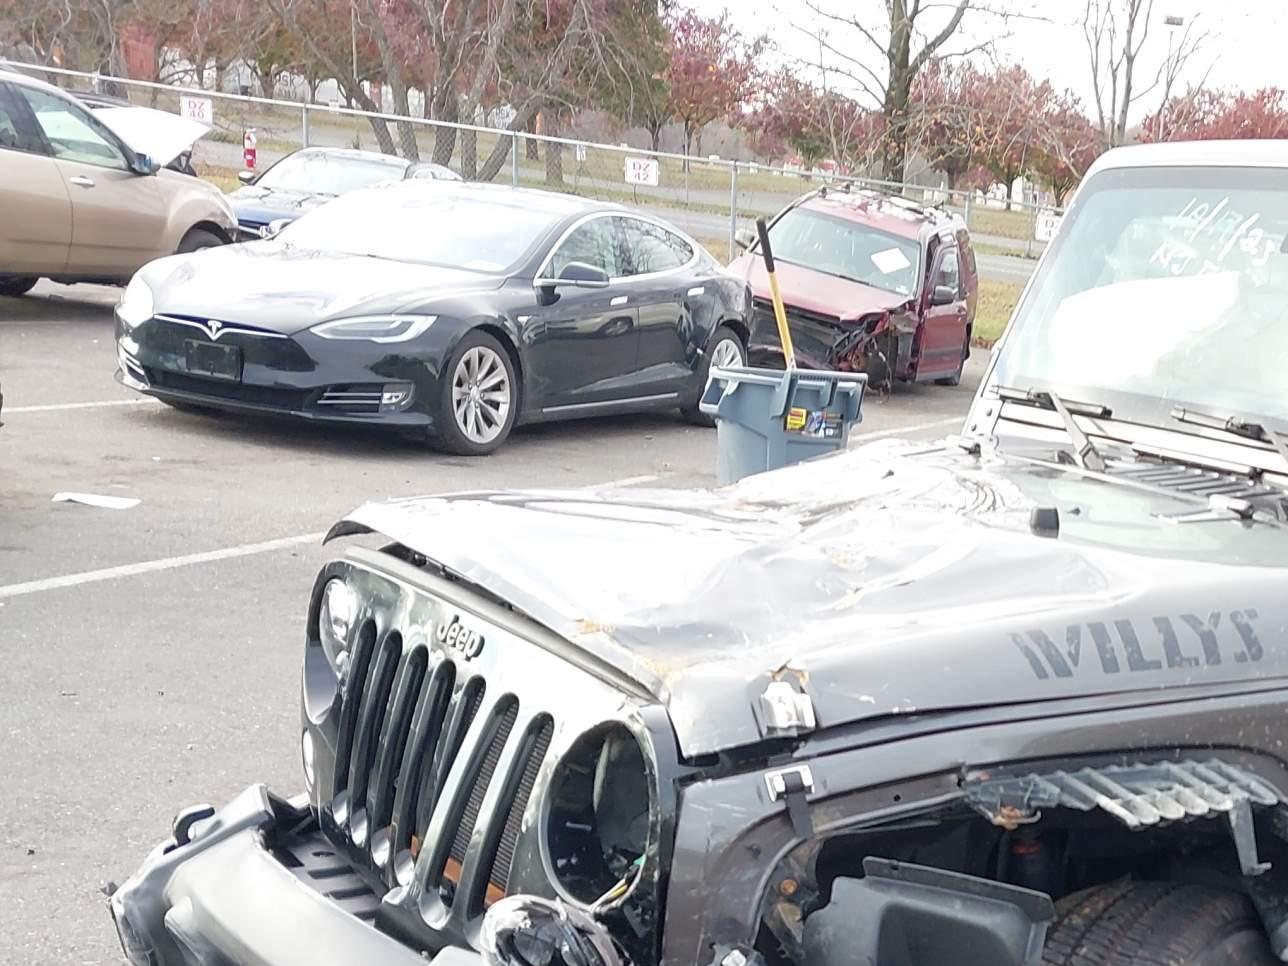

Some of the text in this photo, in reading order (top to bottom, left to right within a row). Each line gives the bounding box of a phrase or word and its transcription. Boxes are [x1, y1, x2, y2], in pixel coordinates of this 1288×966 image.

[632, 161, 650, 171] DZ
[436, 614, 486, 662] Jeep
[1007, 608, 1264, 680] WILLYS
